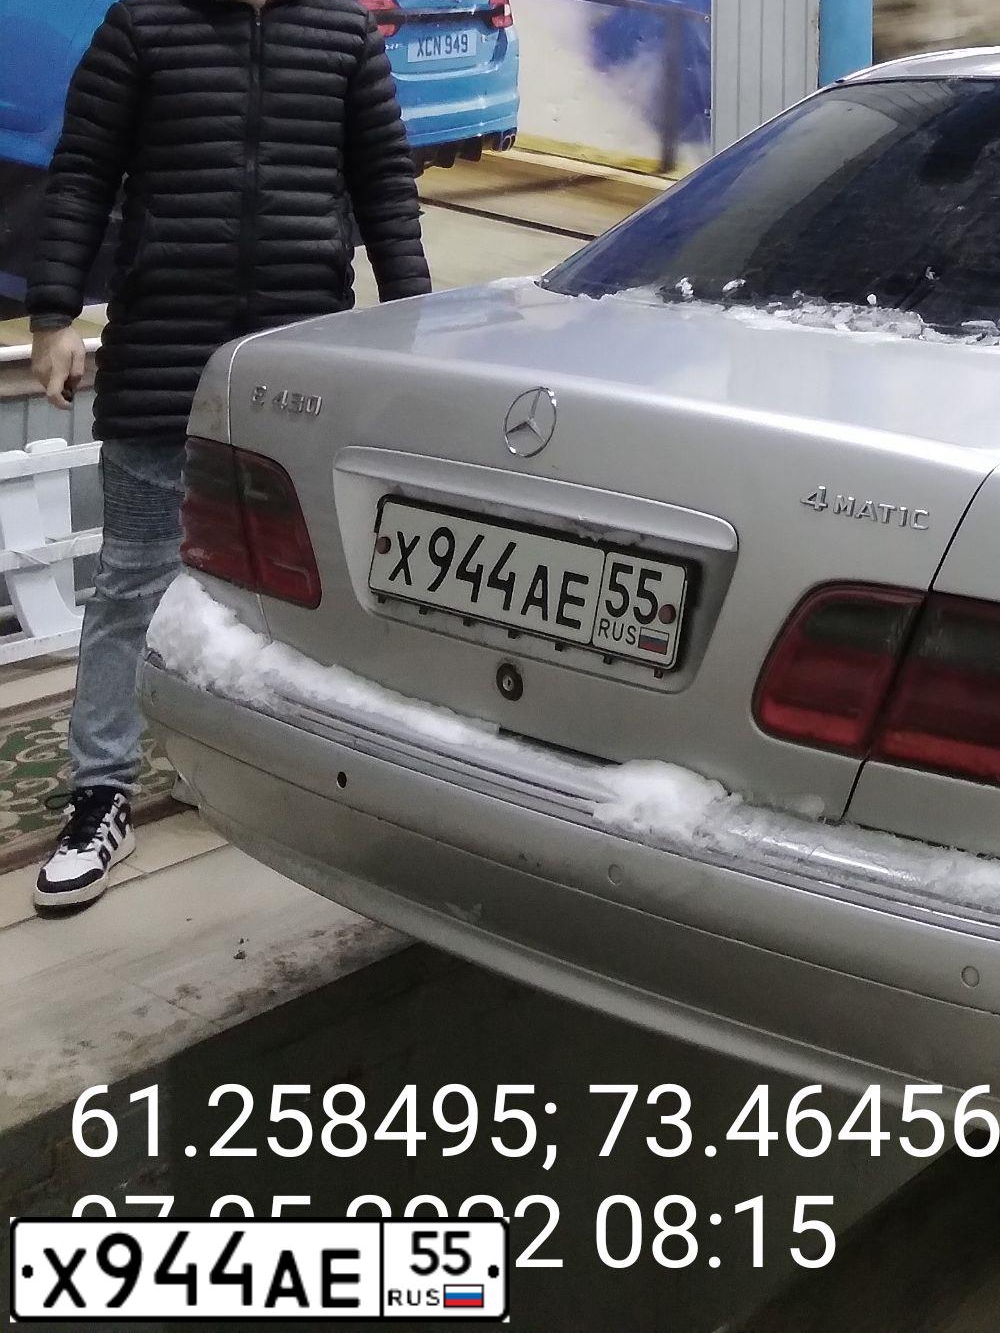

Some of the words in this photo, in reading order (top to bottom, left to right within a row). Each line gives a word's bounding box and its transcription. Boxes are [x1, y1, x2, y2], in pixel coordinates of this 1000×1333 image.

[416, 35, 441, 58] XCN
[444, 33, 469, 55] 949
[271, 389, 323, 417] 430
[604, 561, 663, 626] 55
[598, 619, 637, 645] RUS
